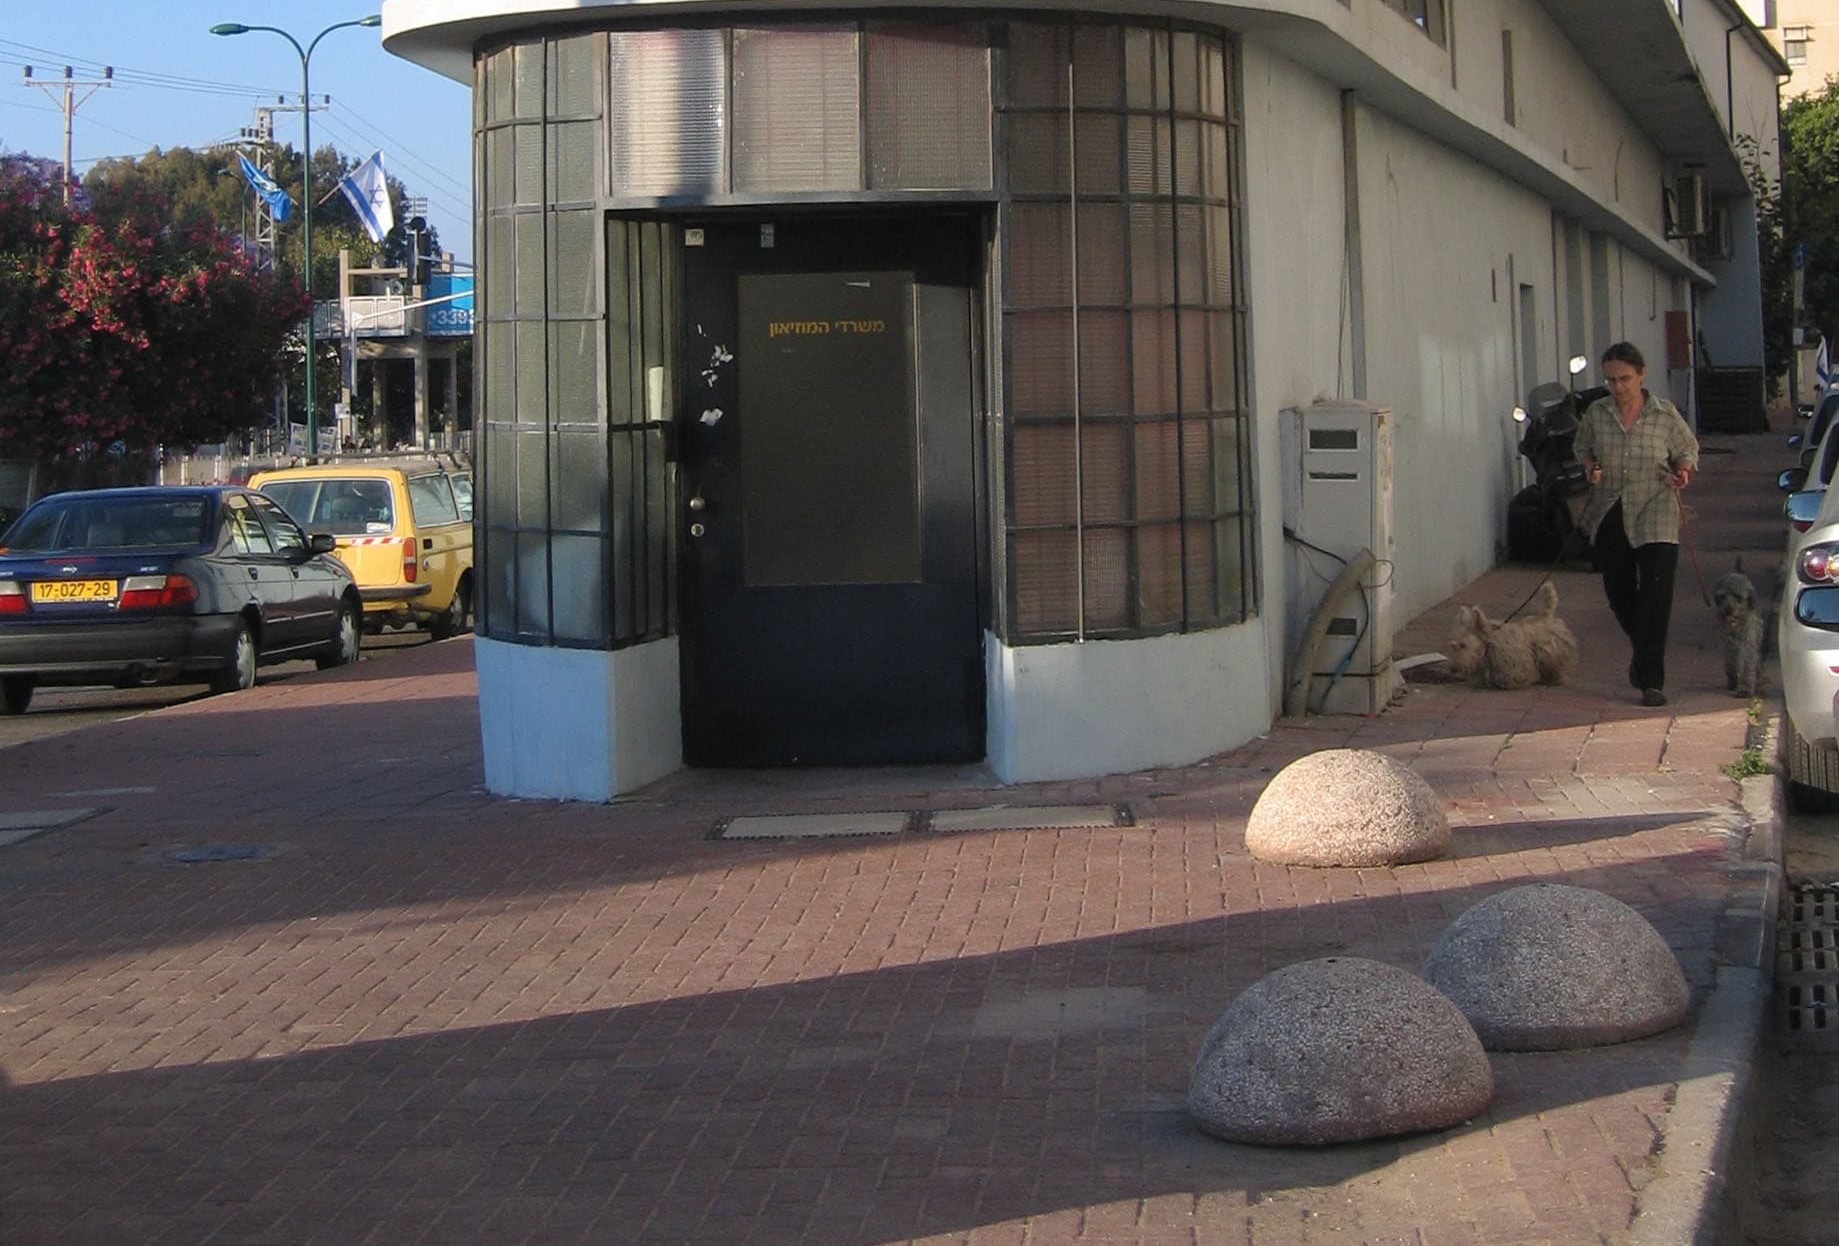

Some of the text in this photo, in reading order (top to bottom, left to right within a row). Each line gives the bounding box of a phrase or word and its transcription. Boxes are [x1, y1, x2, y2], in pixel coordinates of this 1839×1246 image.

[769, 320, 885, 338] משרדי המוזיאון
[39, 581, 110, 598] 17-027-29
